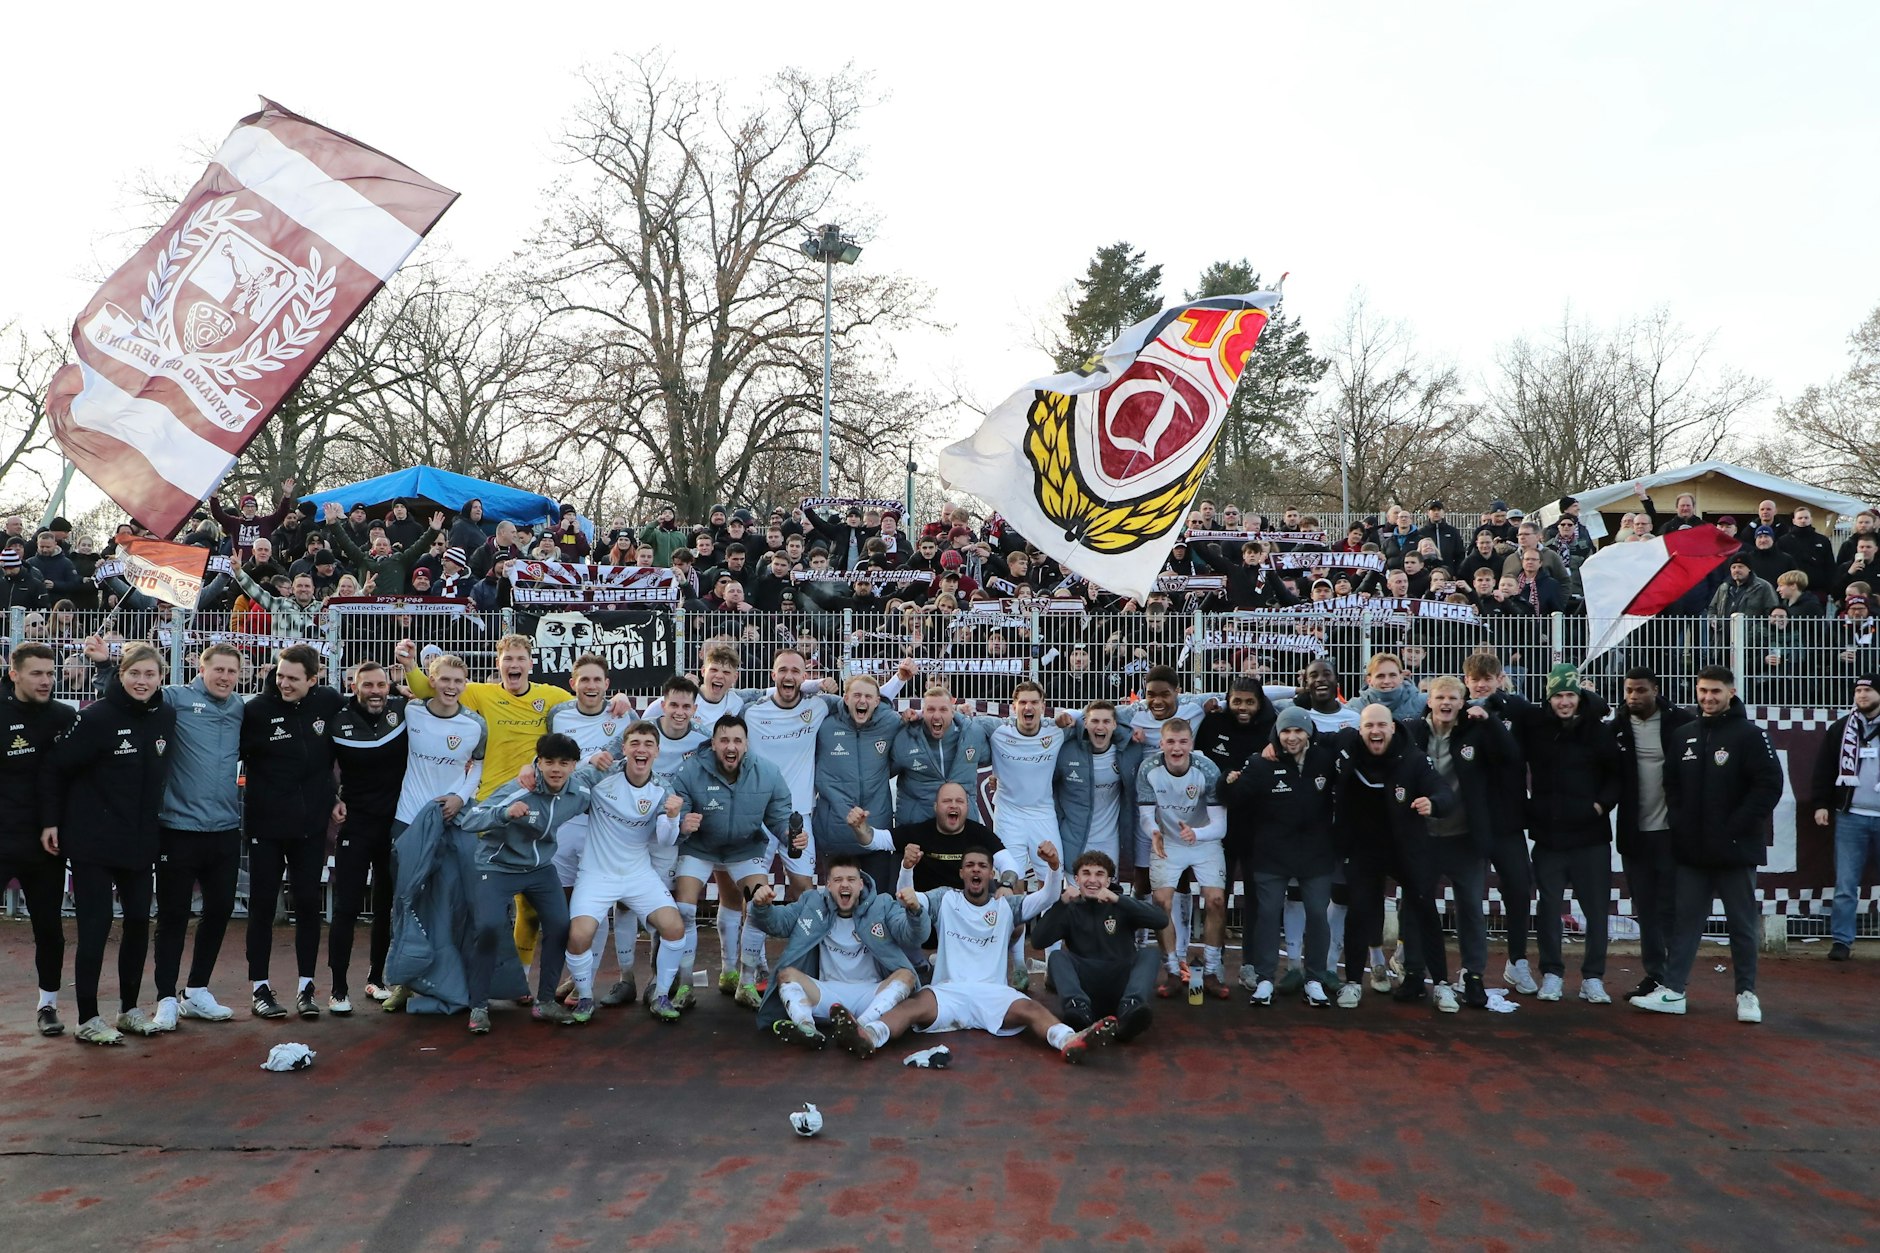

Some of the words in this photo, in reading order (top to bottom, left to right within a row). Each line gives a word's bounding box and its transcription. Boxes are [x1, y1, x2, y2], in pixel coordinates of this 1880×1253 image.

[239, 524, 260, 537] BFC
[515, 588, 584, 602] NIEMALS
[593, 588, 678, 602] AUFGEBEN
[652, 641, 668, 666] H
[944, 659, 1022, 673] DYNAMO
[271, 716, 285, 724] JAKO
[497, 716, 547, 728] crunchfi
[9, 723, 25, 731] JAKO
[117, 728, 131, 736] JAKO
[761, 726, 815, 740] crunchfit
[1002, 753, 1054, 763] crunchfit
